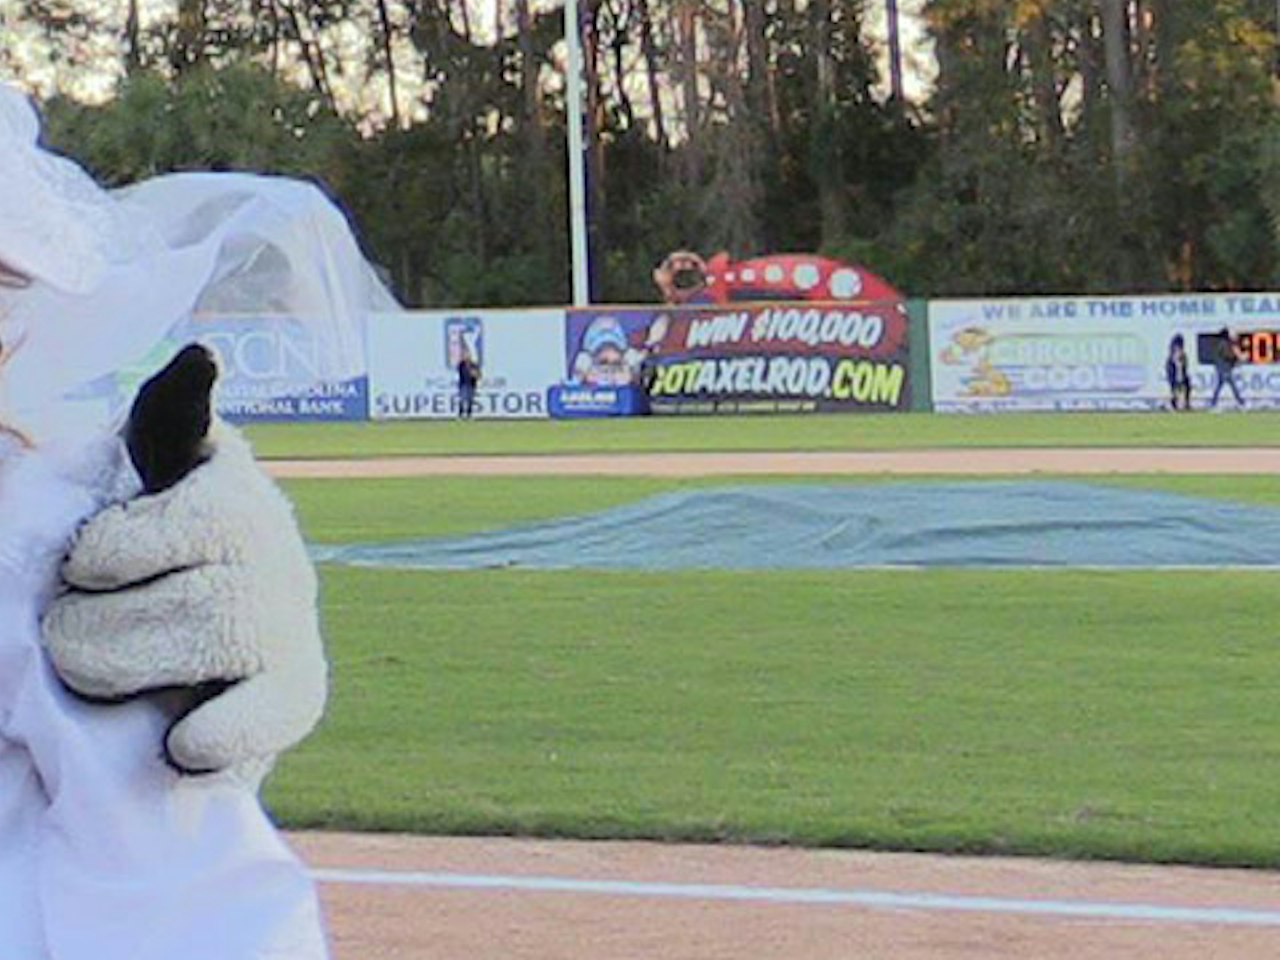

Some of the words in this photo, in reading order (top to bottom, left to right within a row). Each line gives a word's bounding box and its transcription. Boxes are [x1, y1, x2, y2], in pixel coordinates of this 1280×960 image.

[982, 304, 1022, 319] WE
[1030, 302, 1077, 318] ARE
[1088, 301, 1133, 317] THE
[1142, 299, 1216, 316] HOME
[1226, 297, 1280, 315] TEA
[687, 312, 748, 347] WIN
[752, 309, 882, 348] $100,000
[375, 392, 545, 414] SUPESTOR
